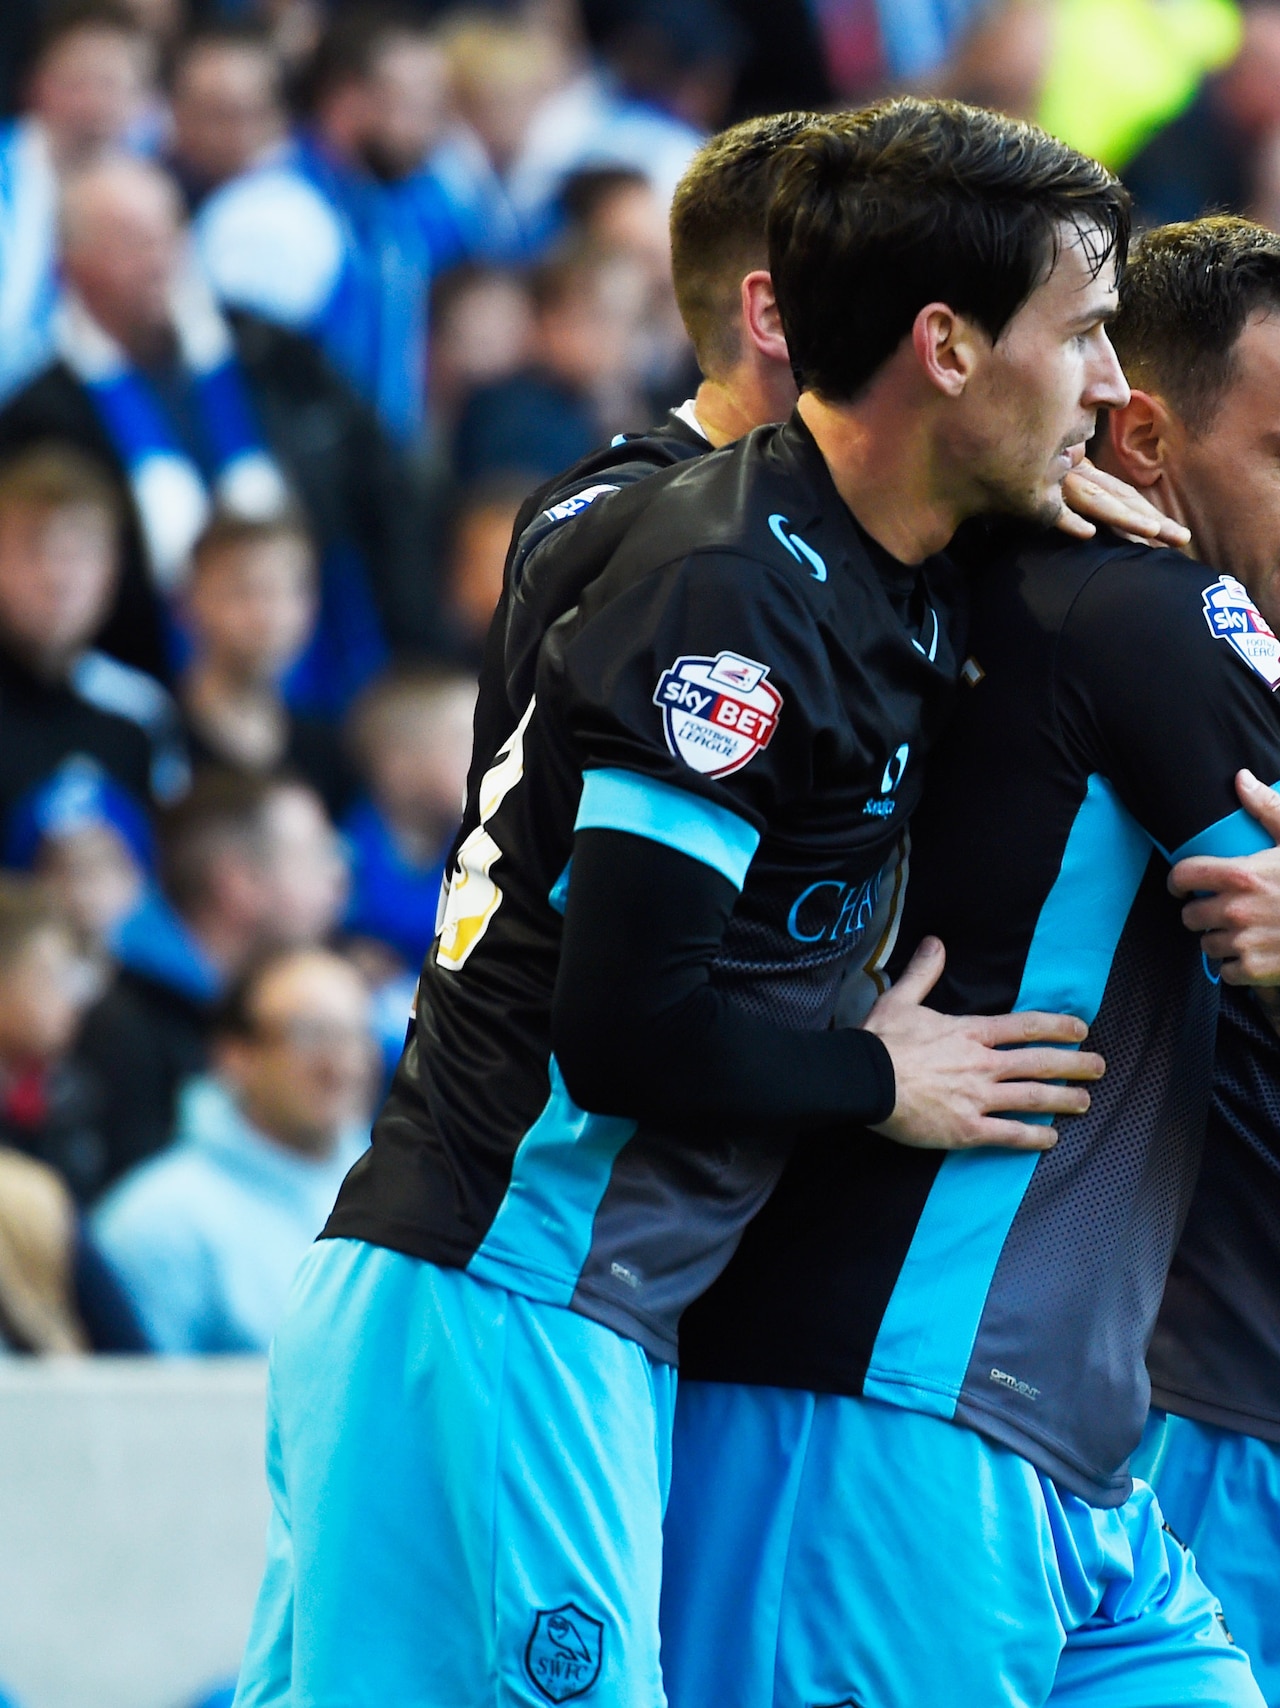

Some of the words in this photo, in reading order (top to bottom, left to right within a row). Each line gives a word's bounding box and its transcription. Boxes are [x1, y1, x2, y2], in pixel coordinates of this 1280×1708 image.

[1213, 607, 1248, 633] sky
[663, 680, 713, 715] sky
[716, 699, 773, 740] BET
[678, 727, 735, 758] LEAGUE
